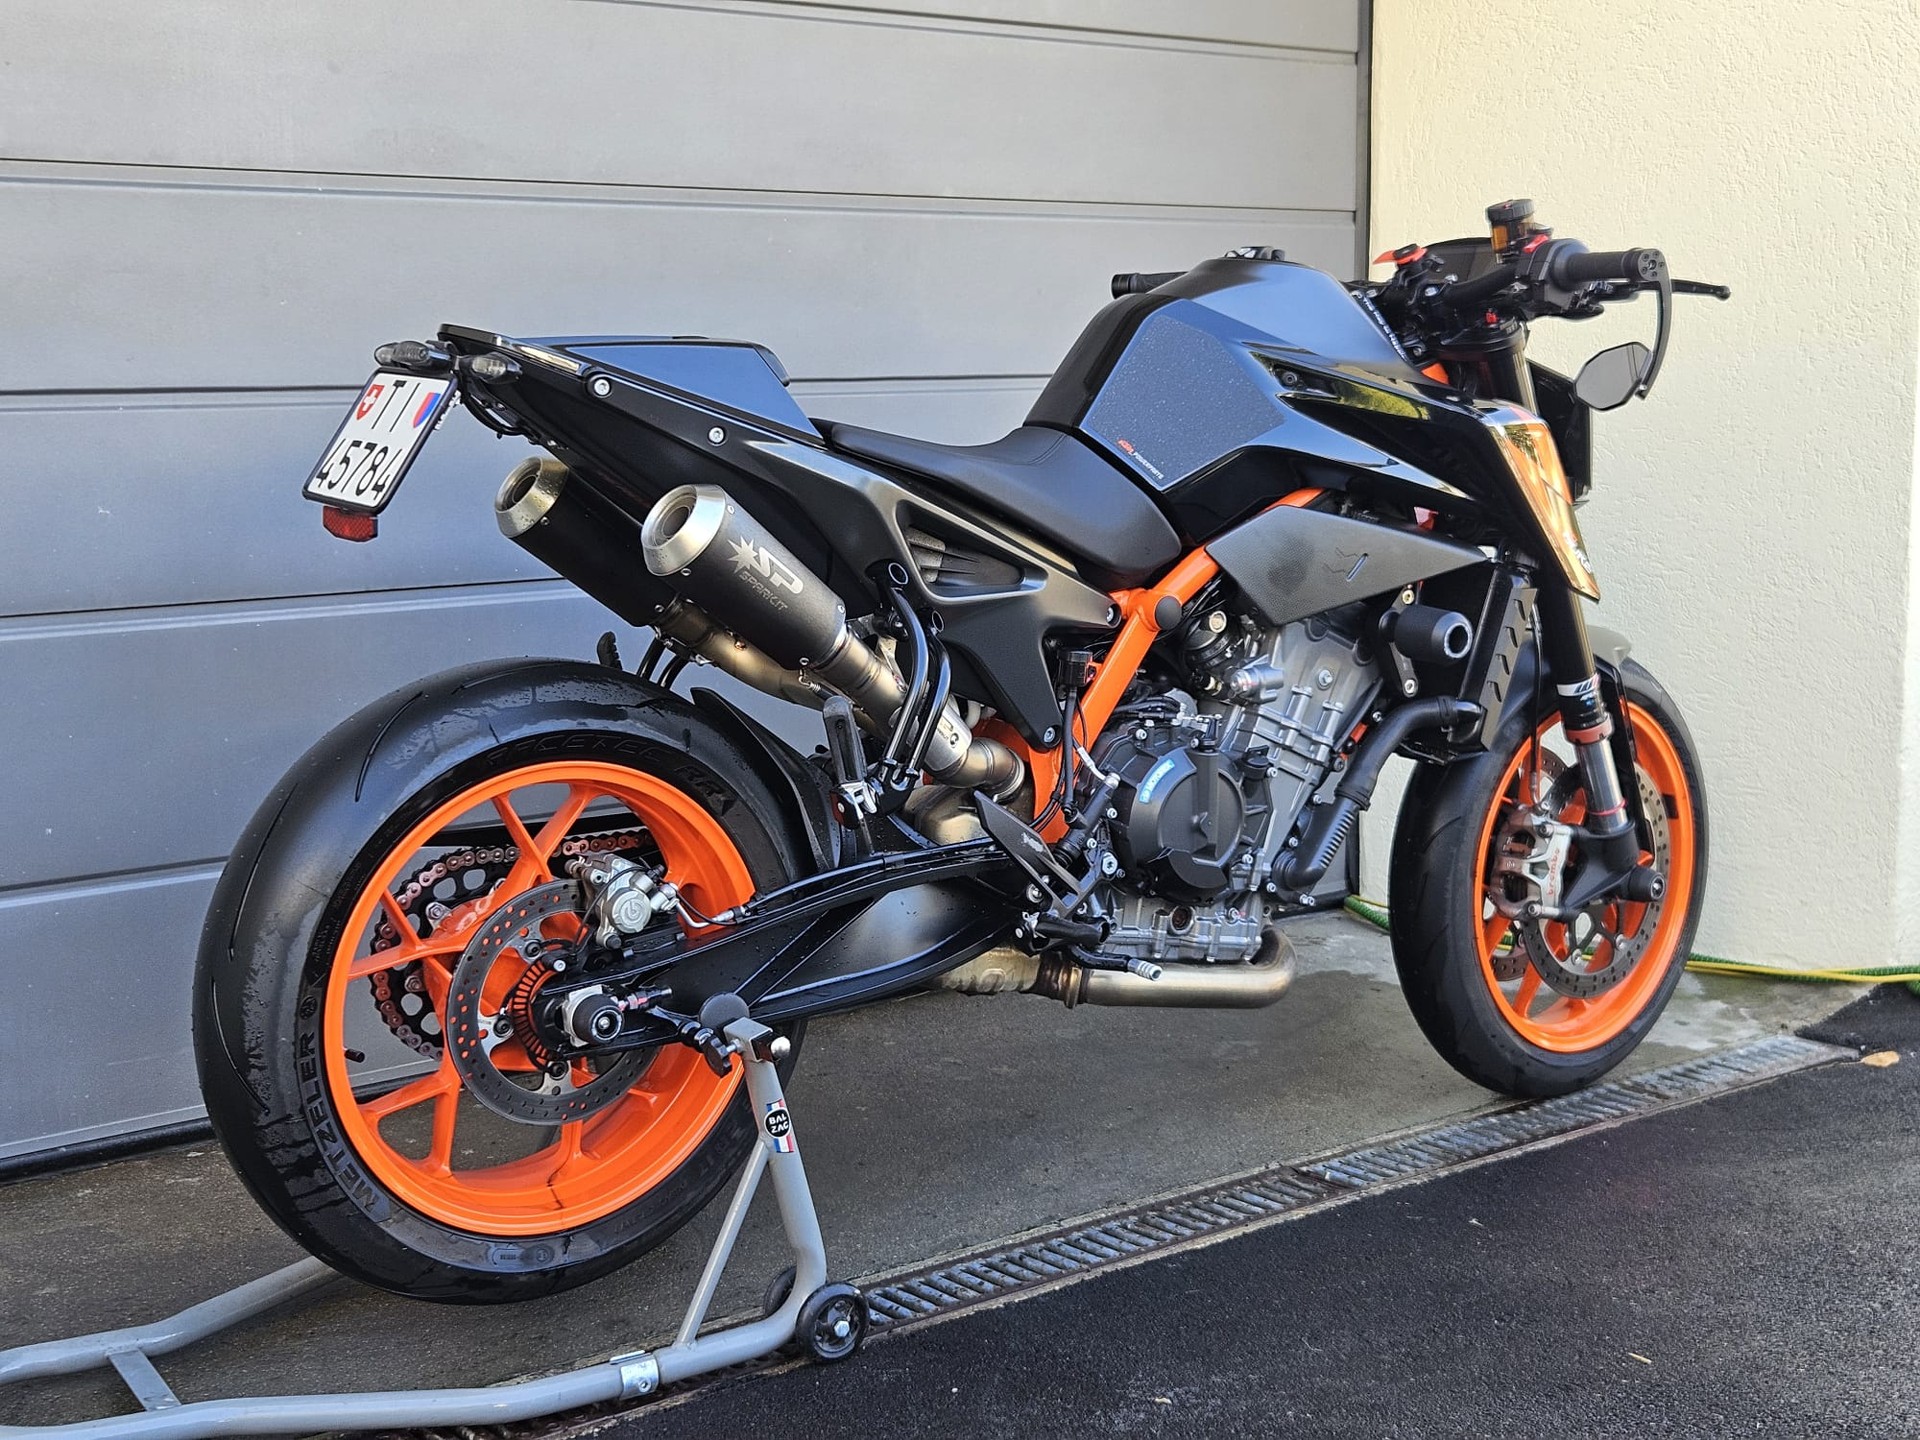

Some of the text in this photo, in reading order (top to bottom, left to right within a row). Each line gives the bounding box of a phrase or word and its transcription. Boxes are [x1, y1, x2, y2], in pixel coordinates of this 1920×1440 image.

[371, 379, 421, 433] TI
[315, 438, 403, 501] 45784
[1547, 848, 1560, 896] brembo
[299, 1030, 380, 1214] METZELER
[768, 1113, 788, 1125] BAL
[770, 1120, 789, 1134] ZAC
